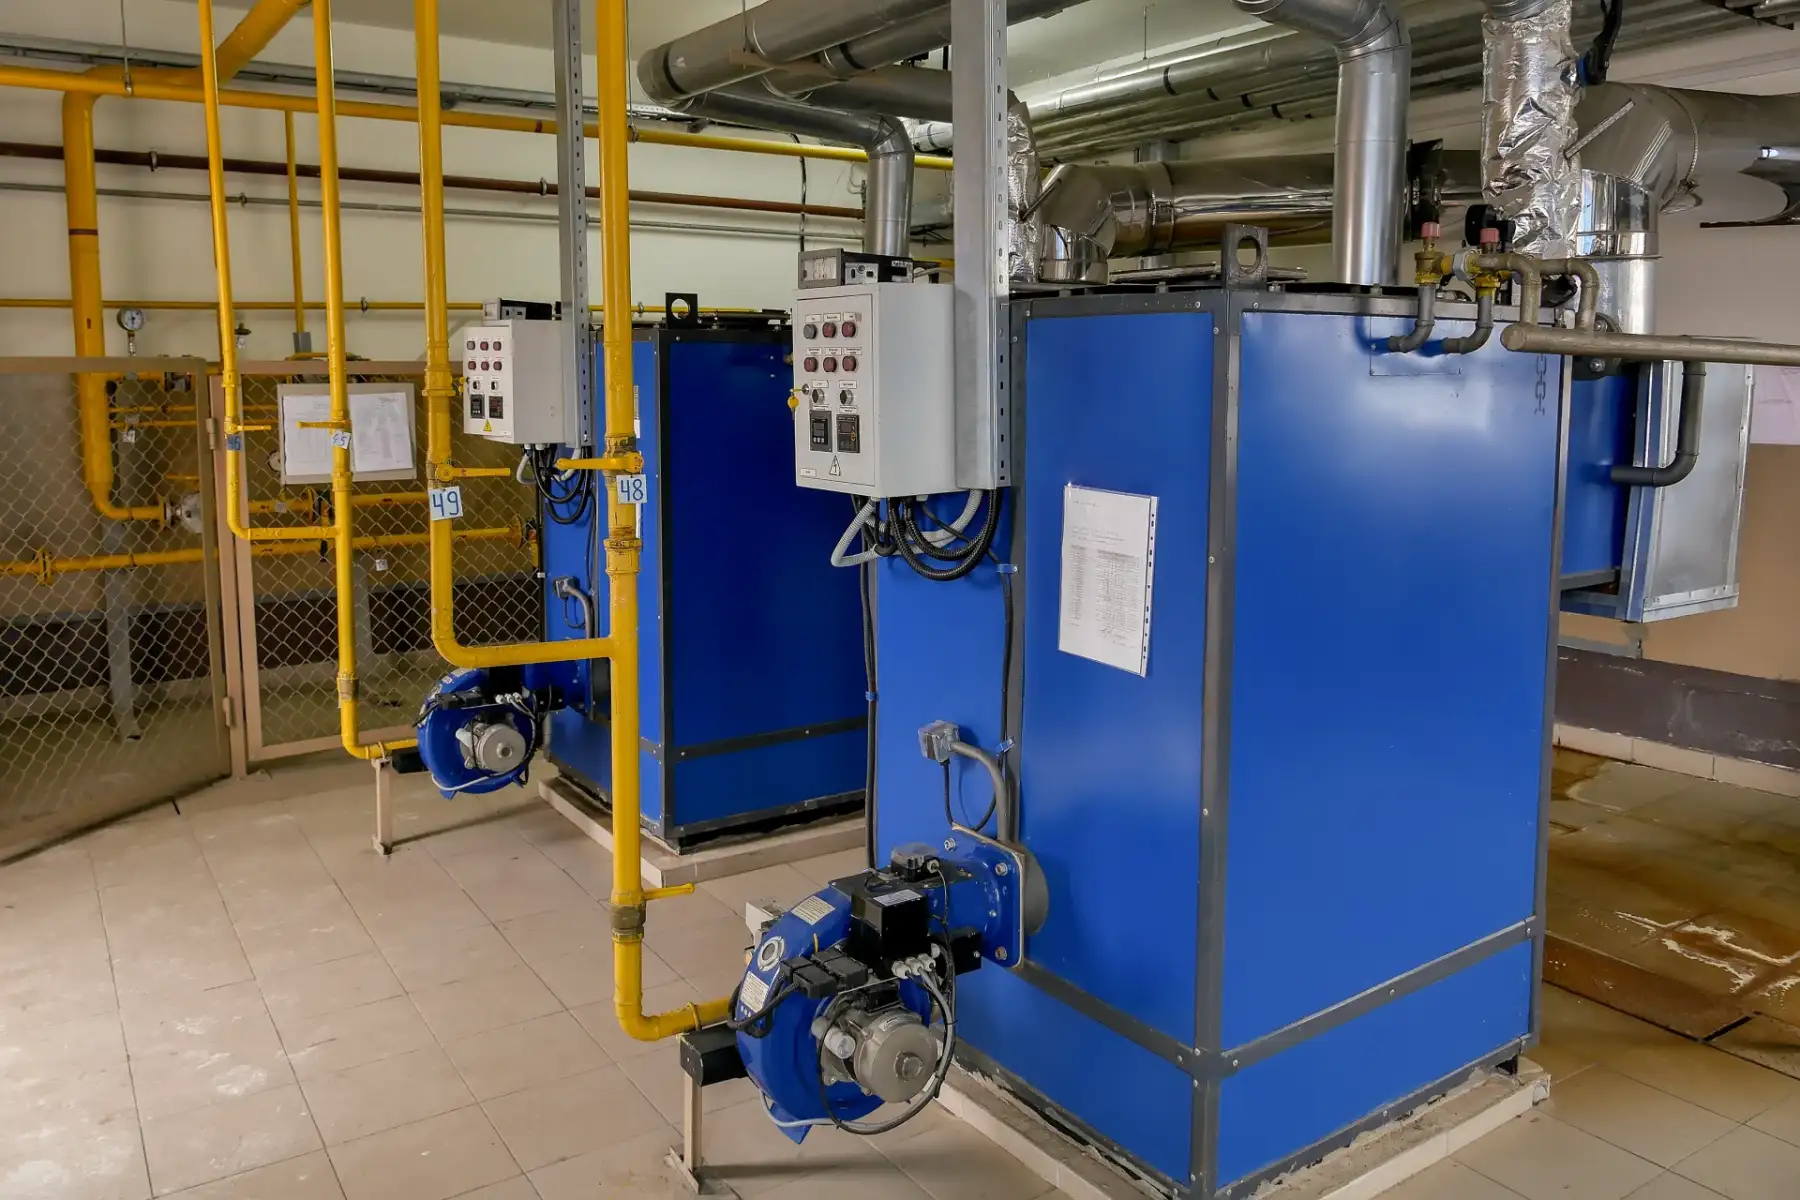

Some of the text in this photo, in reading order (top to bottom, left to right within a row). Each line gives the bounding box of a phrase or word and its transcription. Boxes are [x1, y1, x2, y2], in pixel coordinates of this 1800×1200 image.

[227, 435, 241, 451] 46
[621, 478, 644, 502] 48
[432, 491, 460, 517] 49
